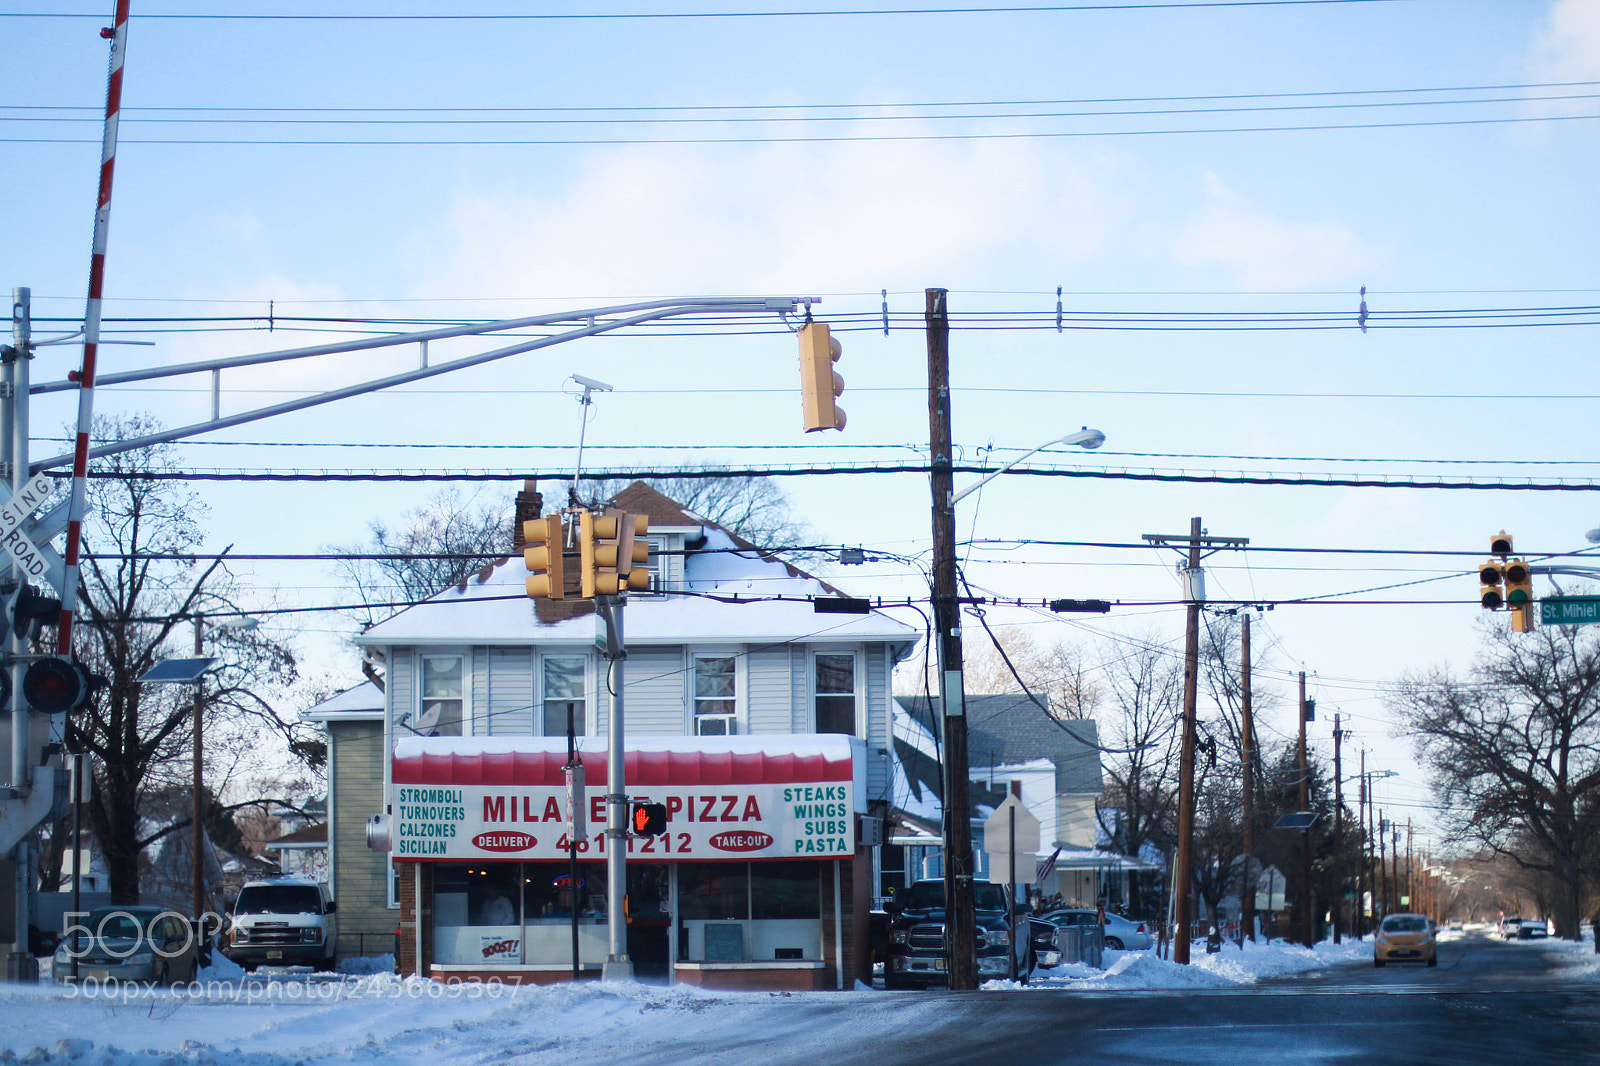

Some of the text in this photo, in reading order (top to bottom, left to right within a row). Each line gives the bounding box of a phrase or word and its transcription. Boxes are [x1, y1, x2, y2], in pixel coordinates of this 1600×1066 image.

[0, 479, 49, 537] SING
[4, 530, 44, 576] ROAD
[1543, 603, 1597, 619] St. Mihiel
[400, 788, 462, 804] STROMBOLI
[783, 786, 847, 803] STEAKS
[400, 805, 465, 821] TURNOVERS
[483, 796, 650, 823] MILAE
[665, 795, 763, 823] PIZZA
[794, 803, 847, 819] WINGS
[400, 822, 457, 838] CALZONES
[804, 820, 847, 836] SUBS
[400, 839, 448, 855] SICILIAN
[478, 836, 532, 847] DELIVERY
[715, 835, 769, 847] TAKE-OUT
[795, 837, 848, 853] PASTA
[481, 939, 520, 958] BOOST!
